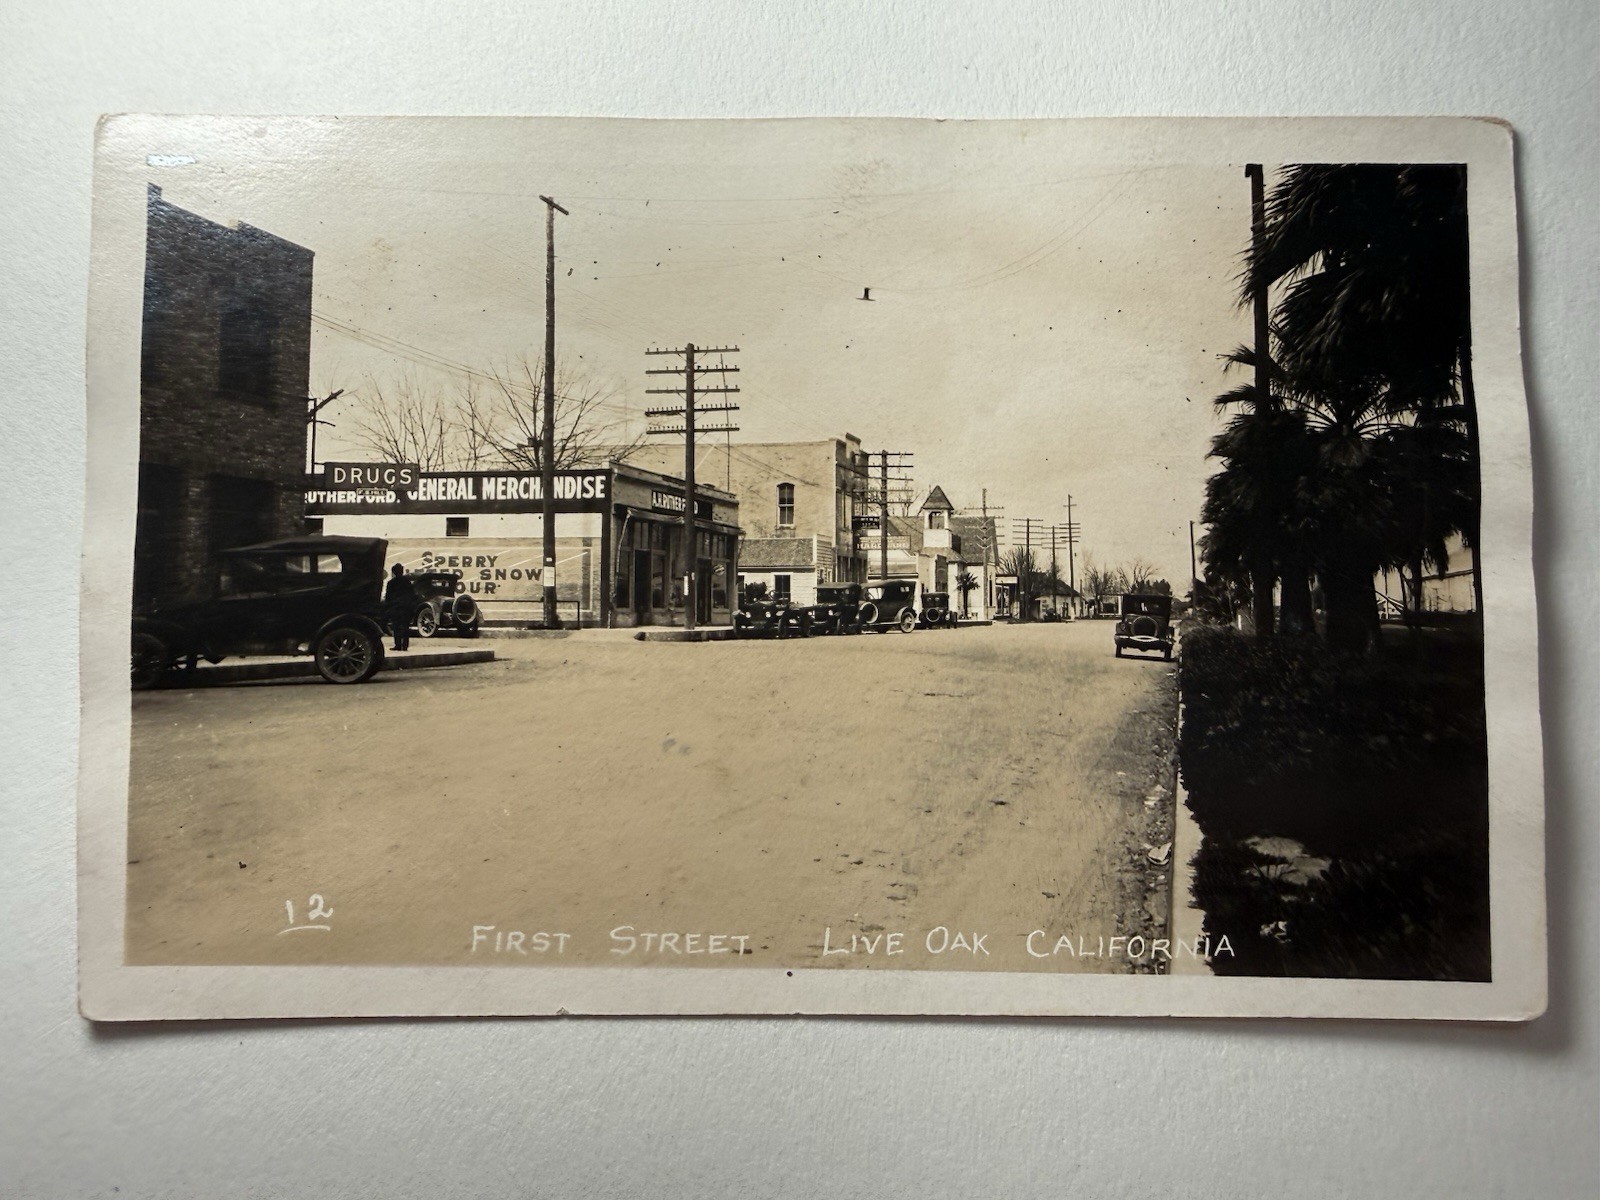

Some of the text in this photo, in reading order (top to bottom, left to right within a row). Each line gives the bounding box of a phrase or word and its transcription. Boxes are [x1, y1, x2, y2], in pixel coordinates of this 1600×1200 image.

[333, 467, 412, 484] DRUGS
[482, 475, 606, 500] MERCHNDISE
[421, 551, 498, 569] SPERRY
[479, 568, 543, 581] SNOW
[285, 893, 334, 924] 12
[470, 925, 1236, 958] FIRST STREET LIVE OAK CALIFORNIA
